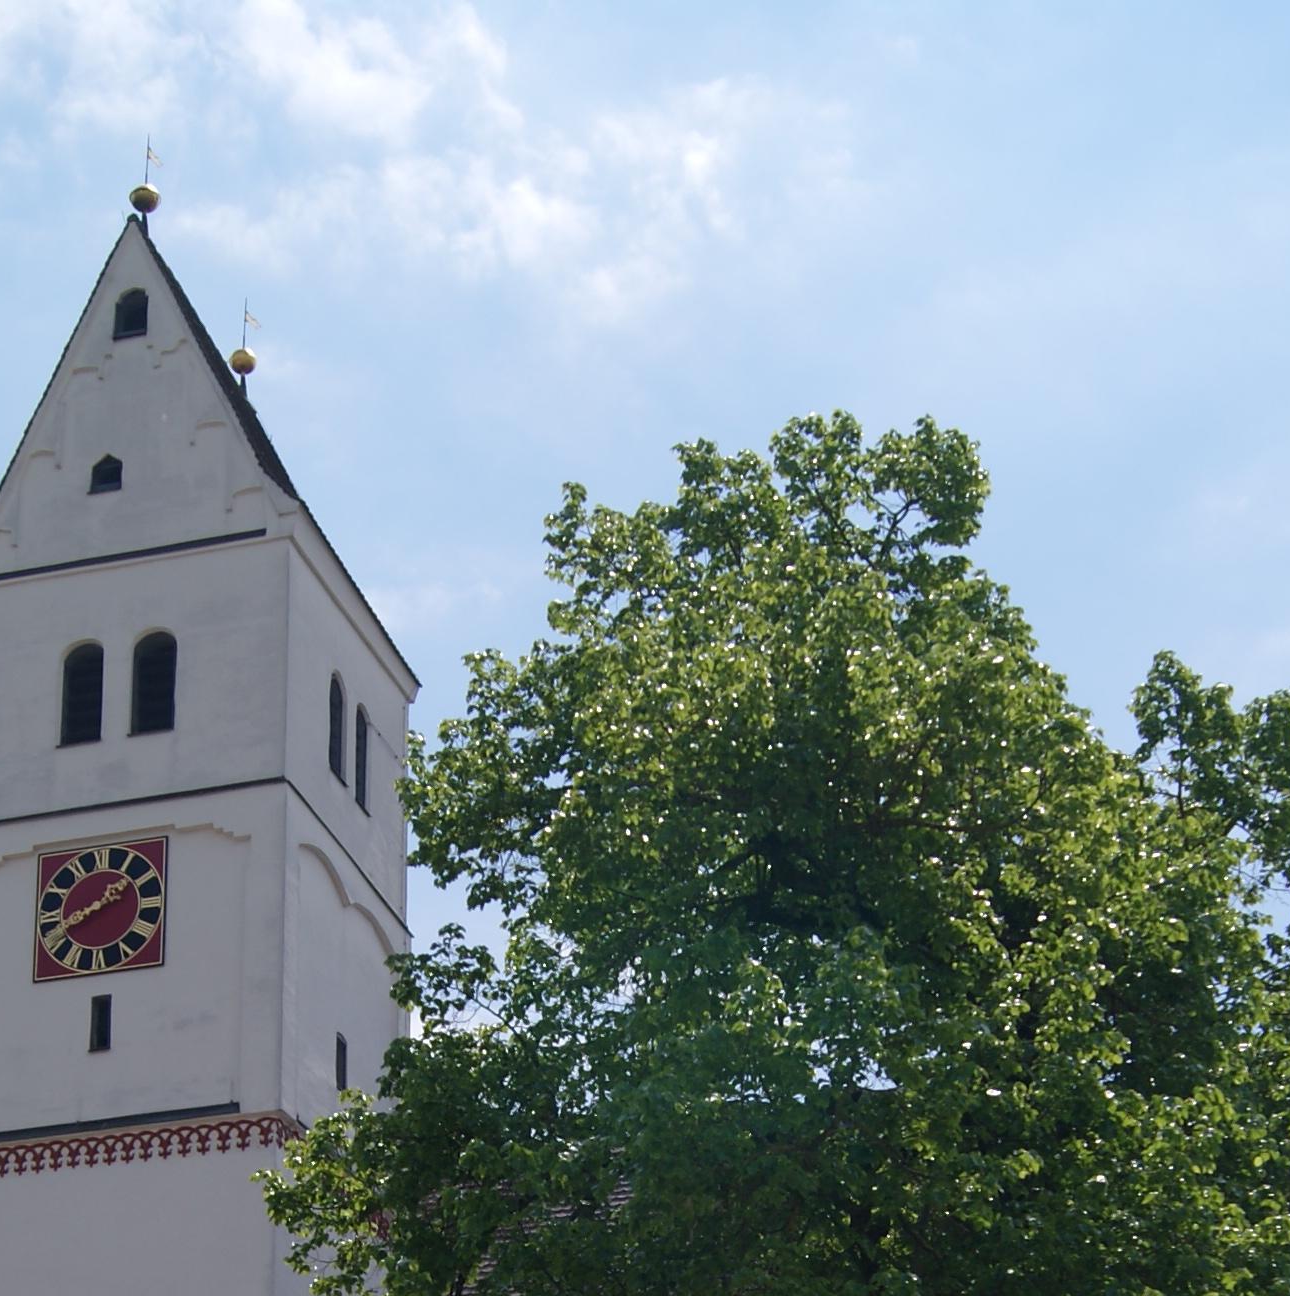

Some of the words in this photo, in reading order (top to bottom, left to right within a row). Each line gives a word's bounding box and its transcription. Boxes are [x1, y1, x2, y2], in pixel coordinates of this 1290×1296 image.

[93, 849, 109, 870] XII
[120, 851, 136, 873] I
[67, 859, 87, 882] XI
[134, 868, 156, 888] II
[47, 880, 69, 899] X
[140, 895, 161, 909] III
[40, 909, 61, 925] IX
[62, 943, 83, 968] VII
[90, 949, 106, 970] VI
[118, 940, 135, 961] V
